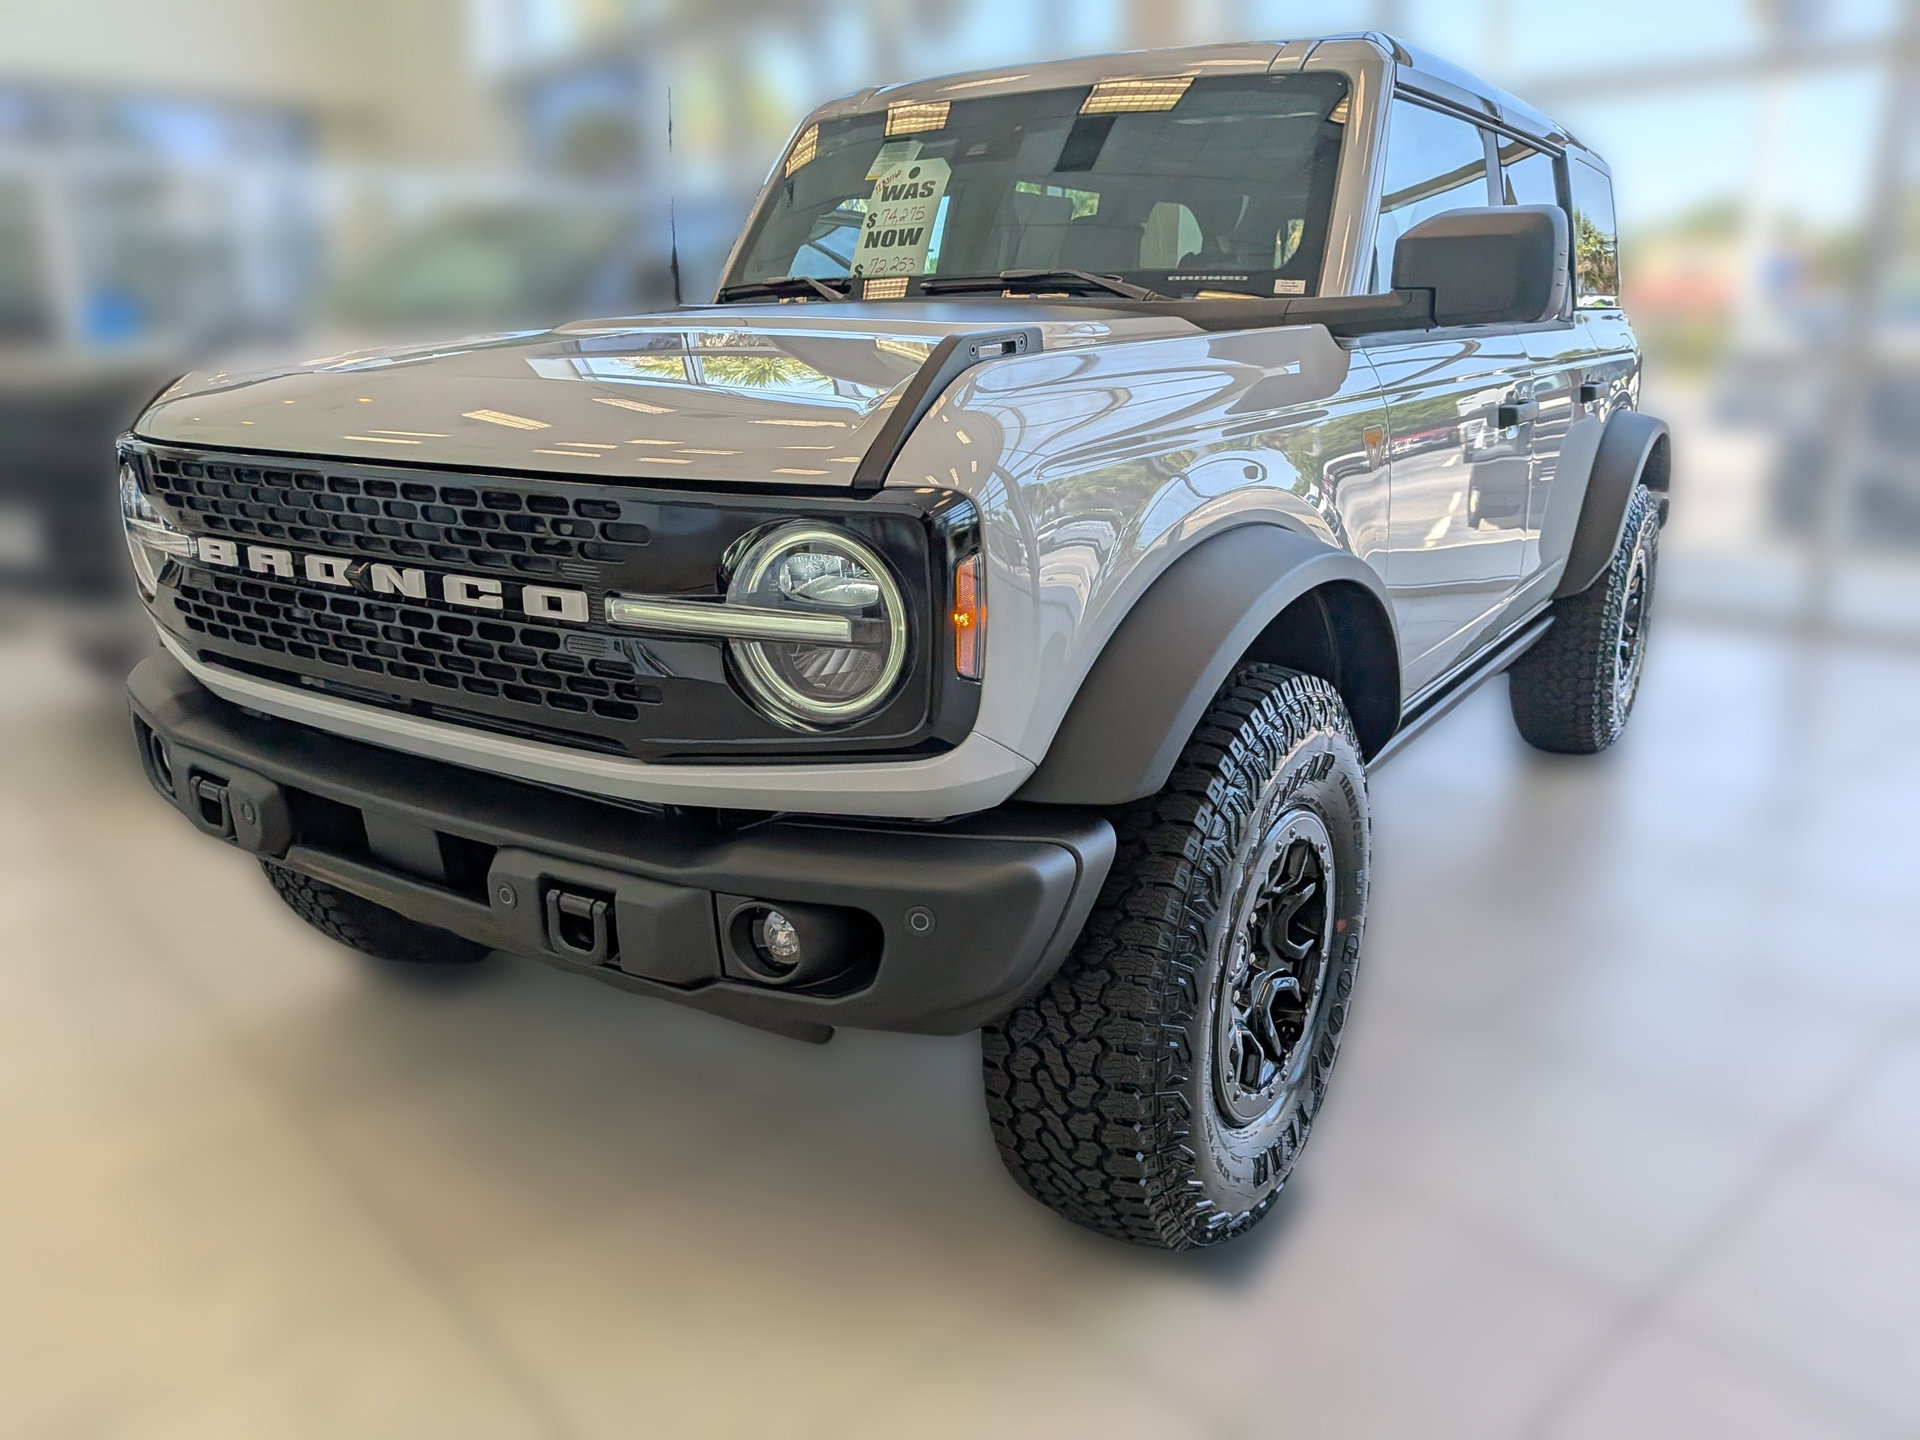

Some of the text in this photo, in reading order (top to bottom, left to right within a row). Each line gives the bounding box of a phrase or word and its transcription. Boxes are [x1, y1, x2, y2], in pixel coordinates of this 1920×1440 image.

[880, 181, 936, 202] WAS
[866, 206, 925, 230] $ 74,275
[864, 227, 924, 248] NOW
[870, 256, 916, 277] 72,253
[198, 536, 590, 624] BRONCO
[1253, 933, 1361, 1189] GOODYEAR
